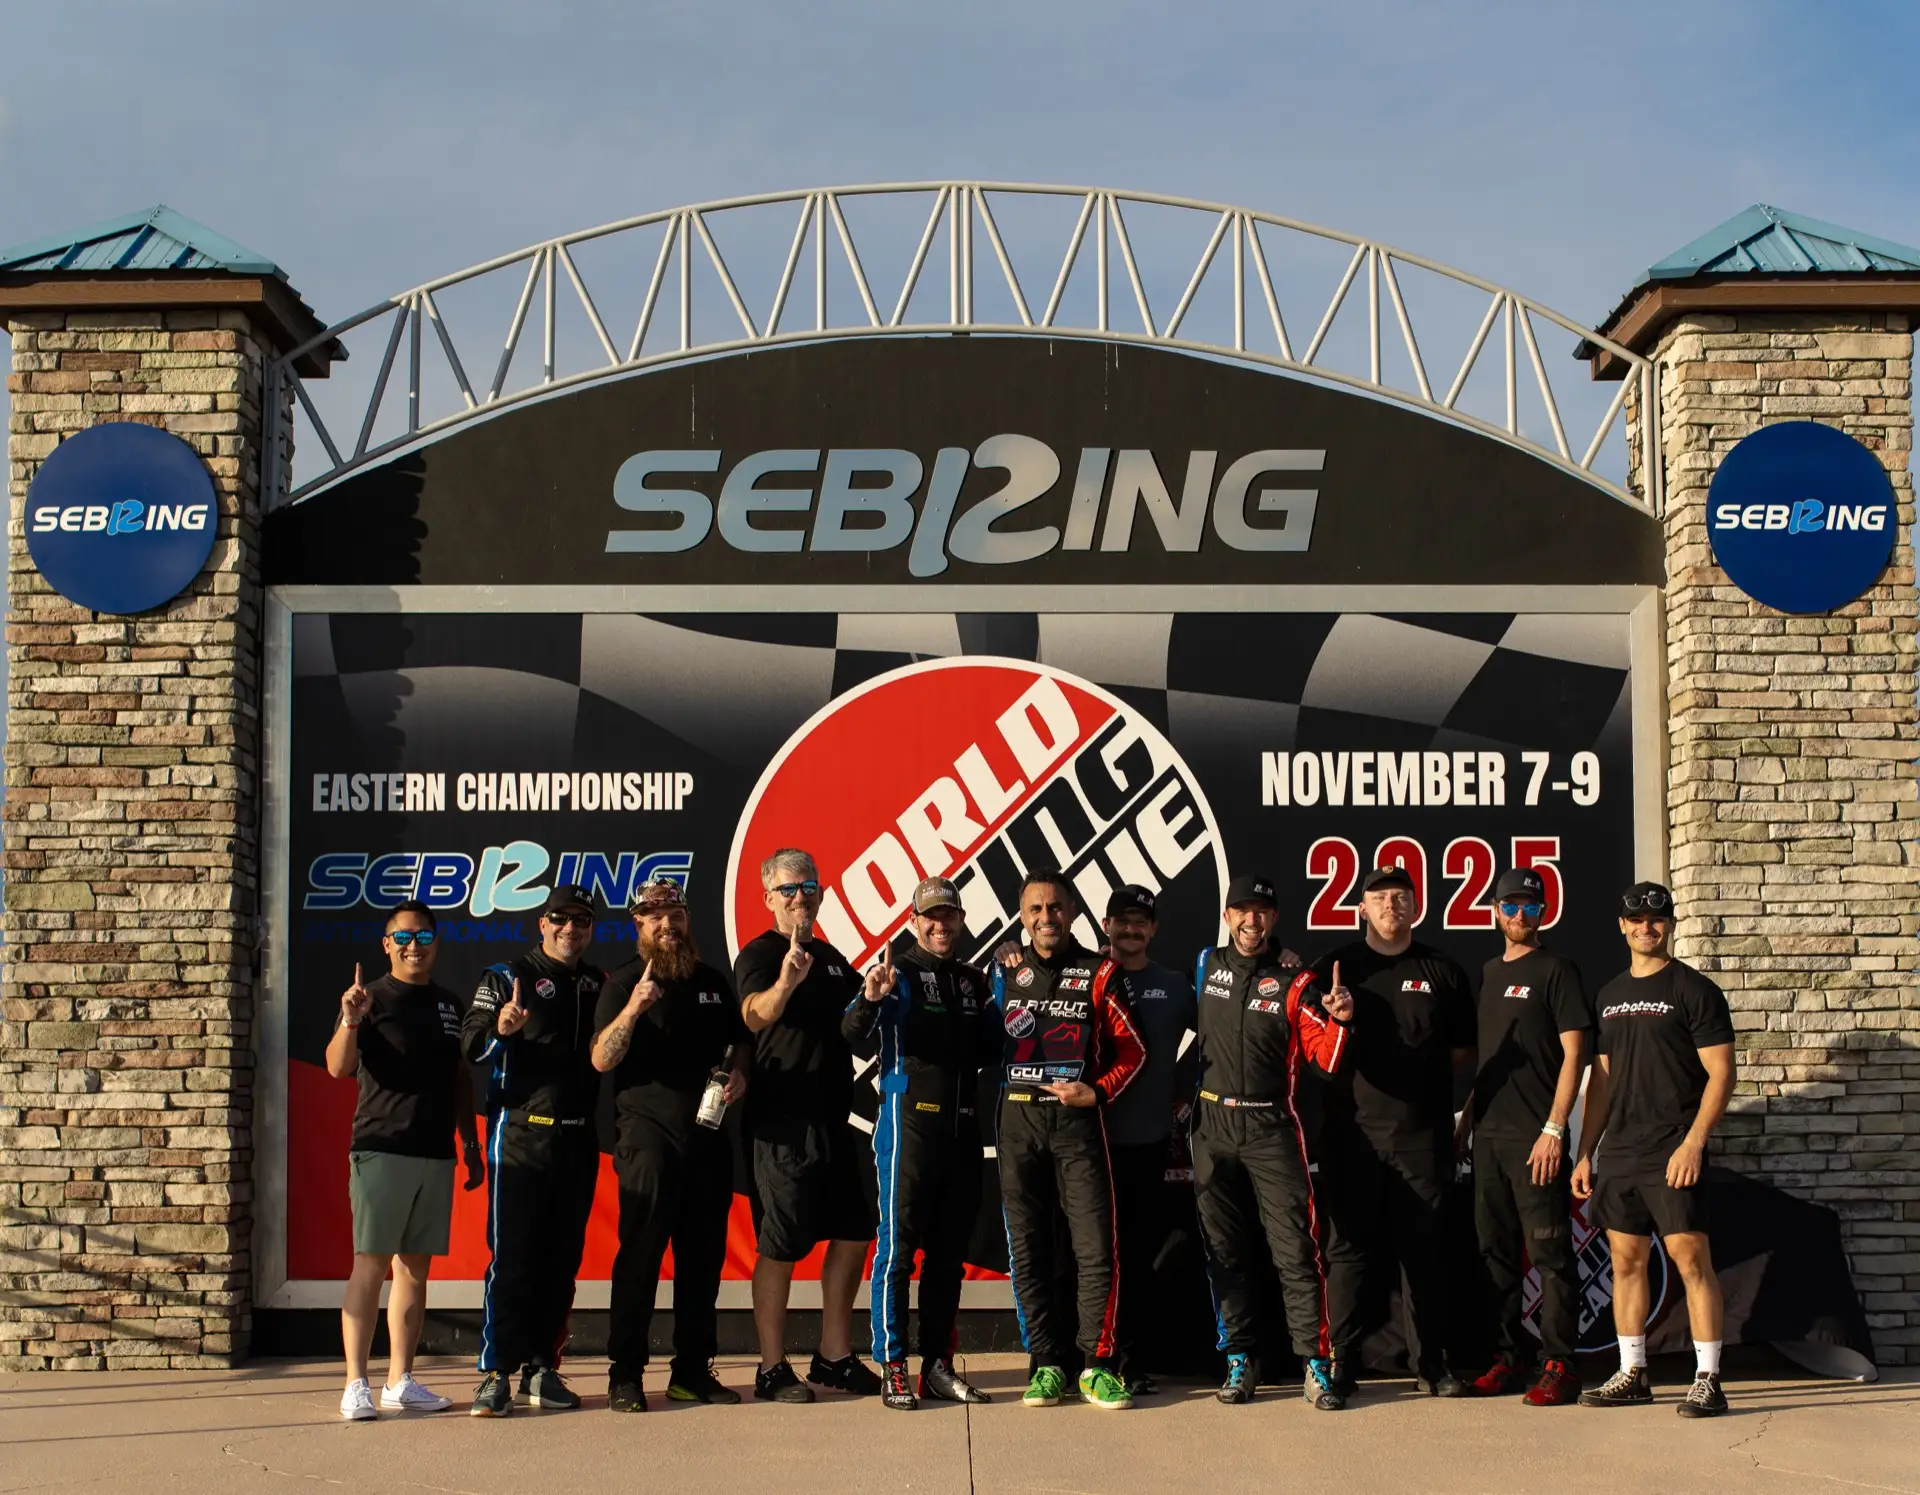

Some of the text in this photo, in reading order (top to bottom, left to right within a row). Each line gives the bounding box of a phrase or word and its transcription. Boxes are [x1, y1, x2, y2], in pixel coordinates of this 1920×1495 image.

[1261, 751, 1600, 806] NOVEMBER 7-9
[312, 772, 694, 812] EASTERN CHAMPIONSHIP
[1206, 985, 1230, 998] SCCA
[1051, 1011, 1088, 1019] RACING
[1602, 1001, 1669, 1018] Carbotech
